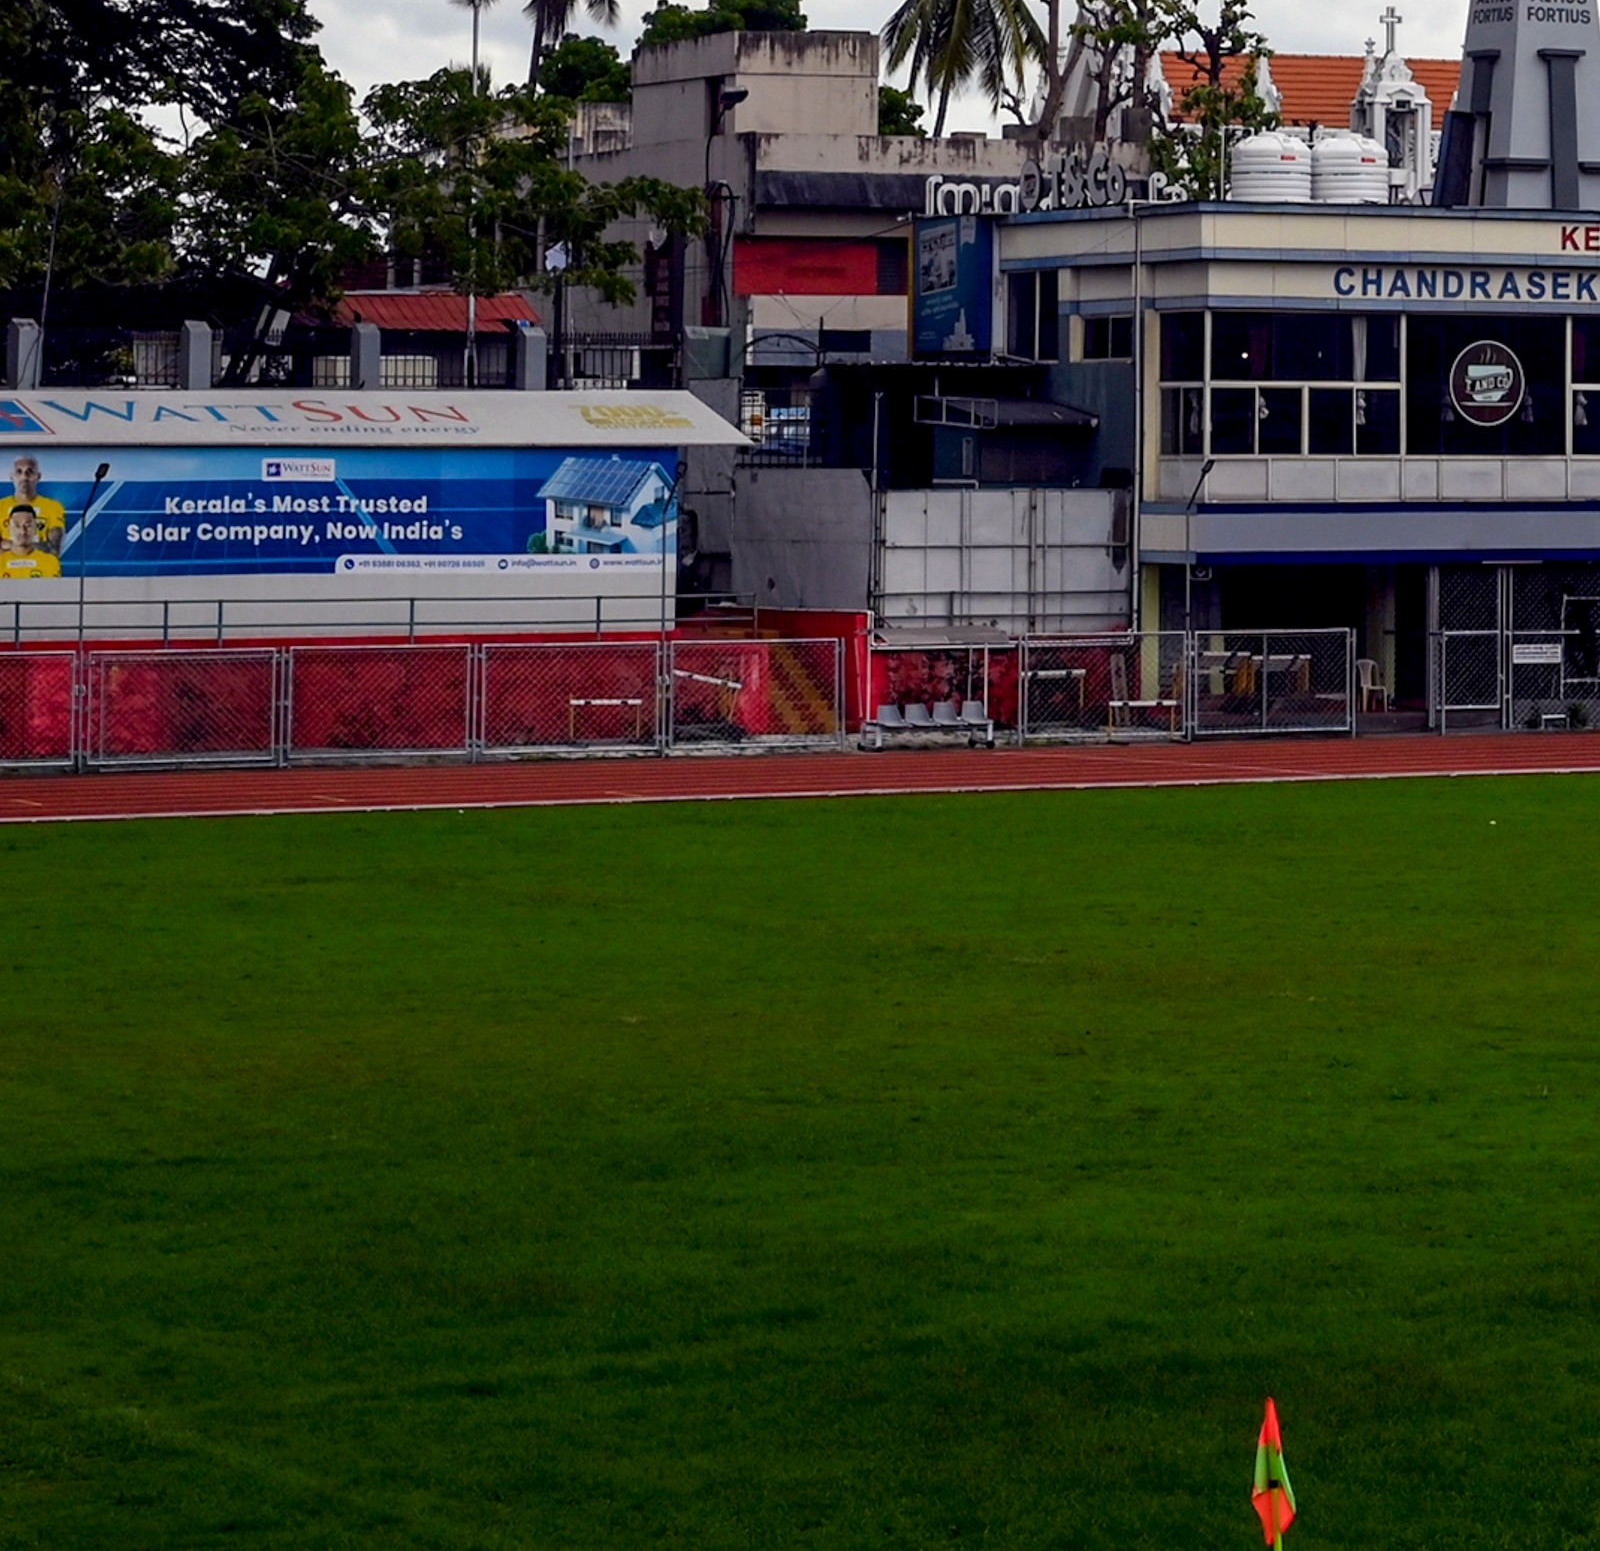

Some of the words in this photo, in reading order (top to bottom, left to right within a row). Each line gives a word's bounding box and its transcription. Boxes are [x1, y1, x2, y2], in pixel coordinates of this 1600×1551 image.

[1472, 6, 1514, 26] FORTIUS
[1527, 6, 1591, 25] FORTIUS
[230, 424, 300, 434] Never
[310, 424, 393, 435] ending
[401, 424, 480, 435] energy
[164, 492, 267, 515] Kerala’s
[272, 495, 331, 513] Most
[335, 495, 428, 513] Trusted
[126, 523, 191, 542] Solar
[196, 522, 321, 546] Company,
[326, 522, 377, 540] Now
[383, 519, 463, 541] India’s
